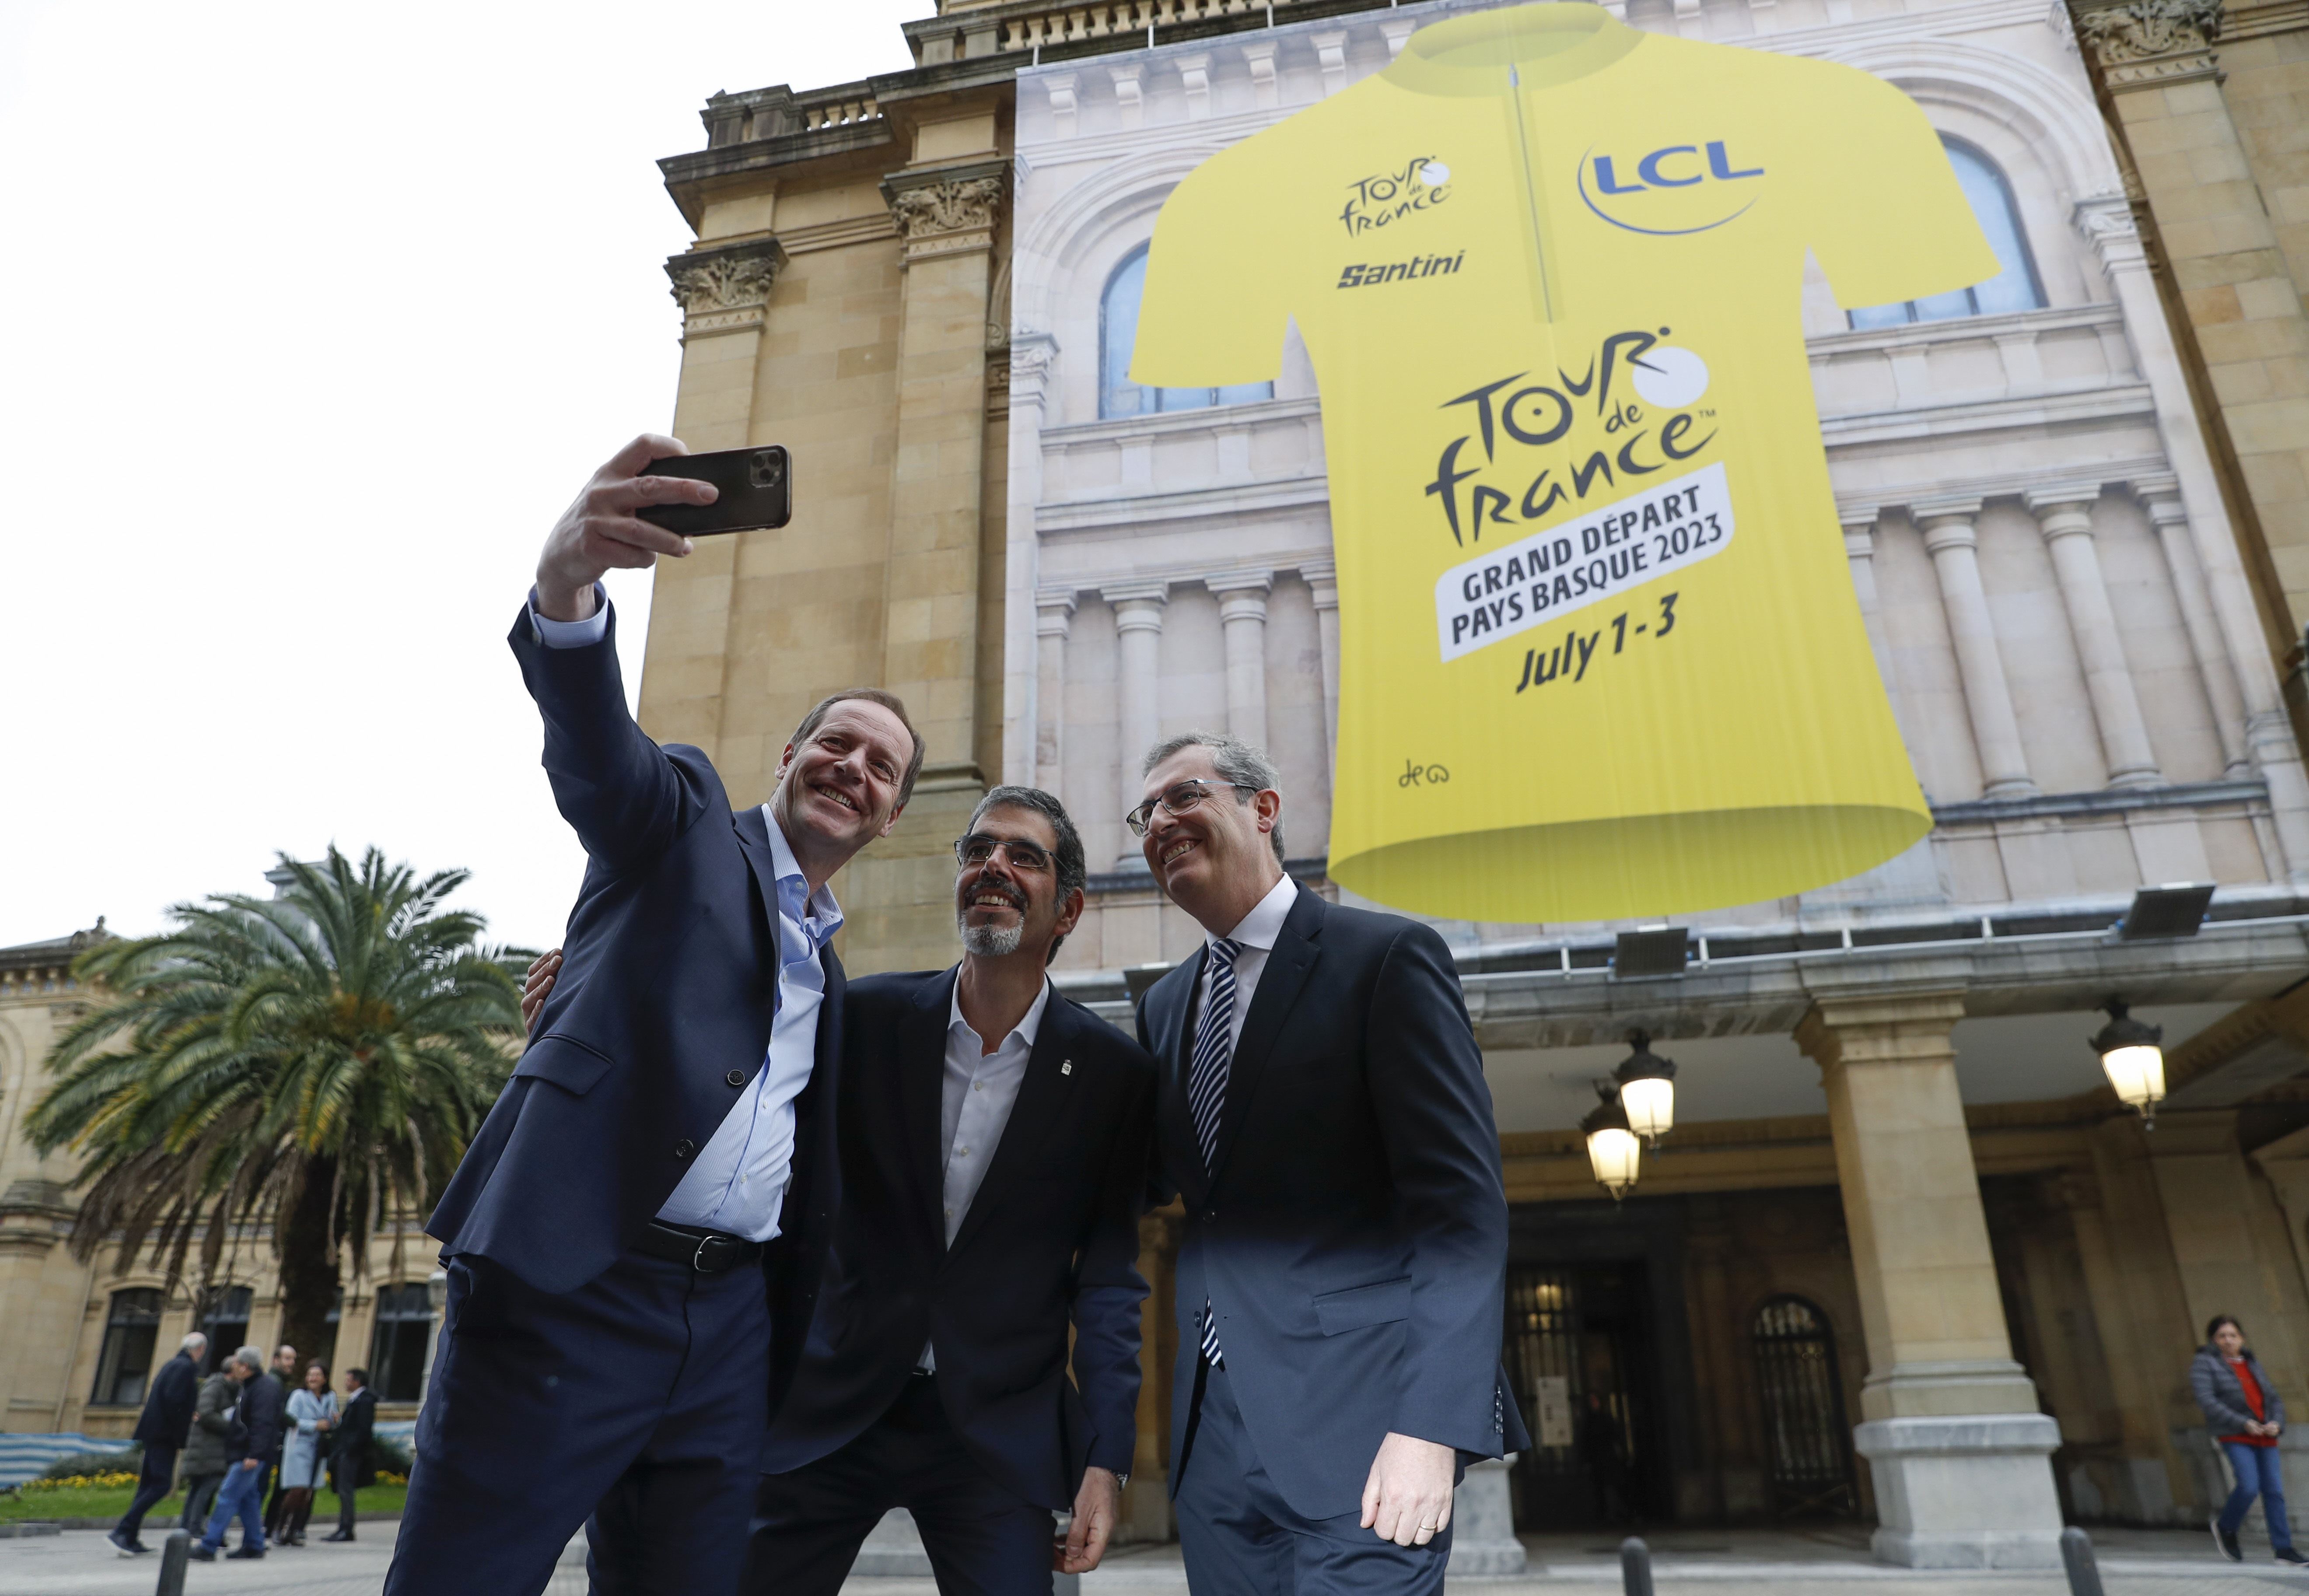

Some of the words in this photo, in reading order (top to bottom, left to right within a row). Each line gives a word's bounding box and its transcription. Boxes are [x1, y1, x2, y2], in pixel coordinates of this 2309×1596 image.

[1409, 183, 1424, 195] de
[1593, 140, 1765, 195] LCL
[1337, 249, 1466, 288] Santini
[1605, 399, 1643, 434] de
[1463, 538, 1572, 602] GRAND
[1581, 485, 1700, 555] DÉPART
[1452, 592, 1523, 644] PAYS
[1531, 542, 1648, 612] BASQUE
[1653, 513, 1722, 564] 2023
[1516, 630, 1601, 693] July
